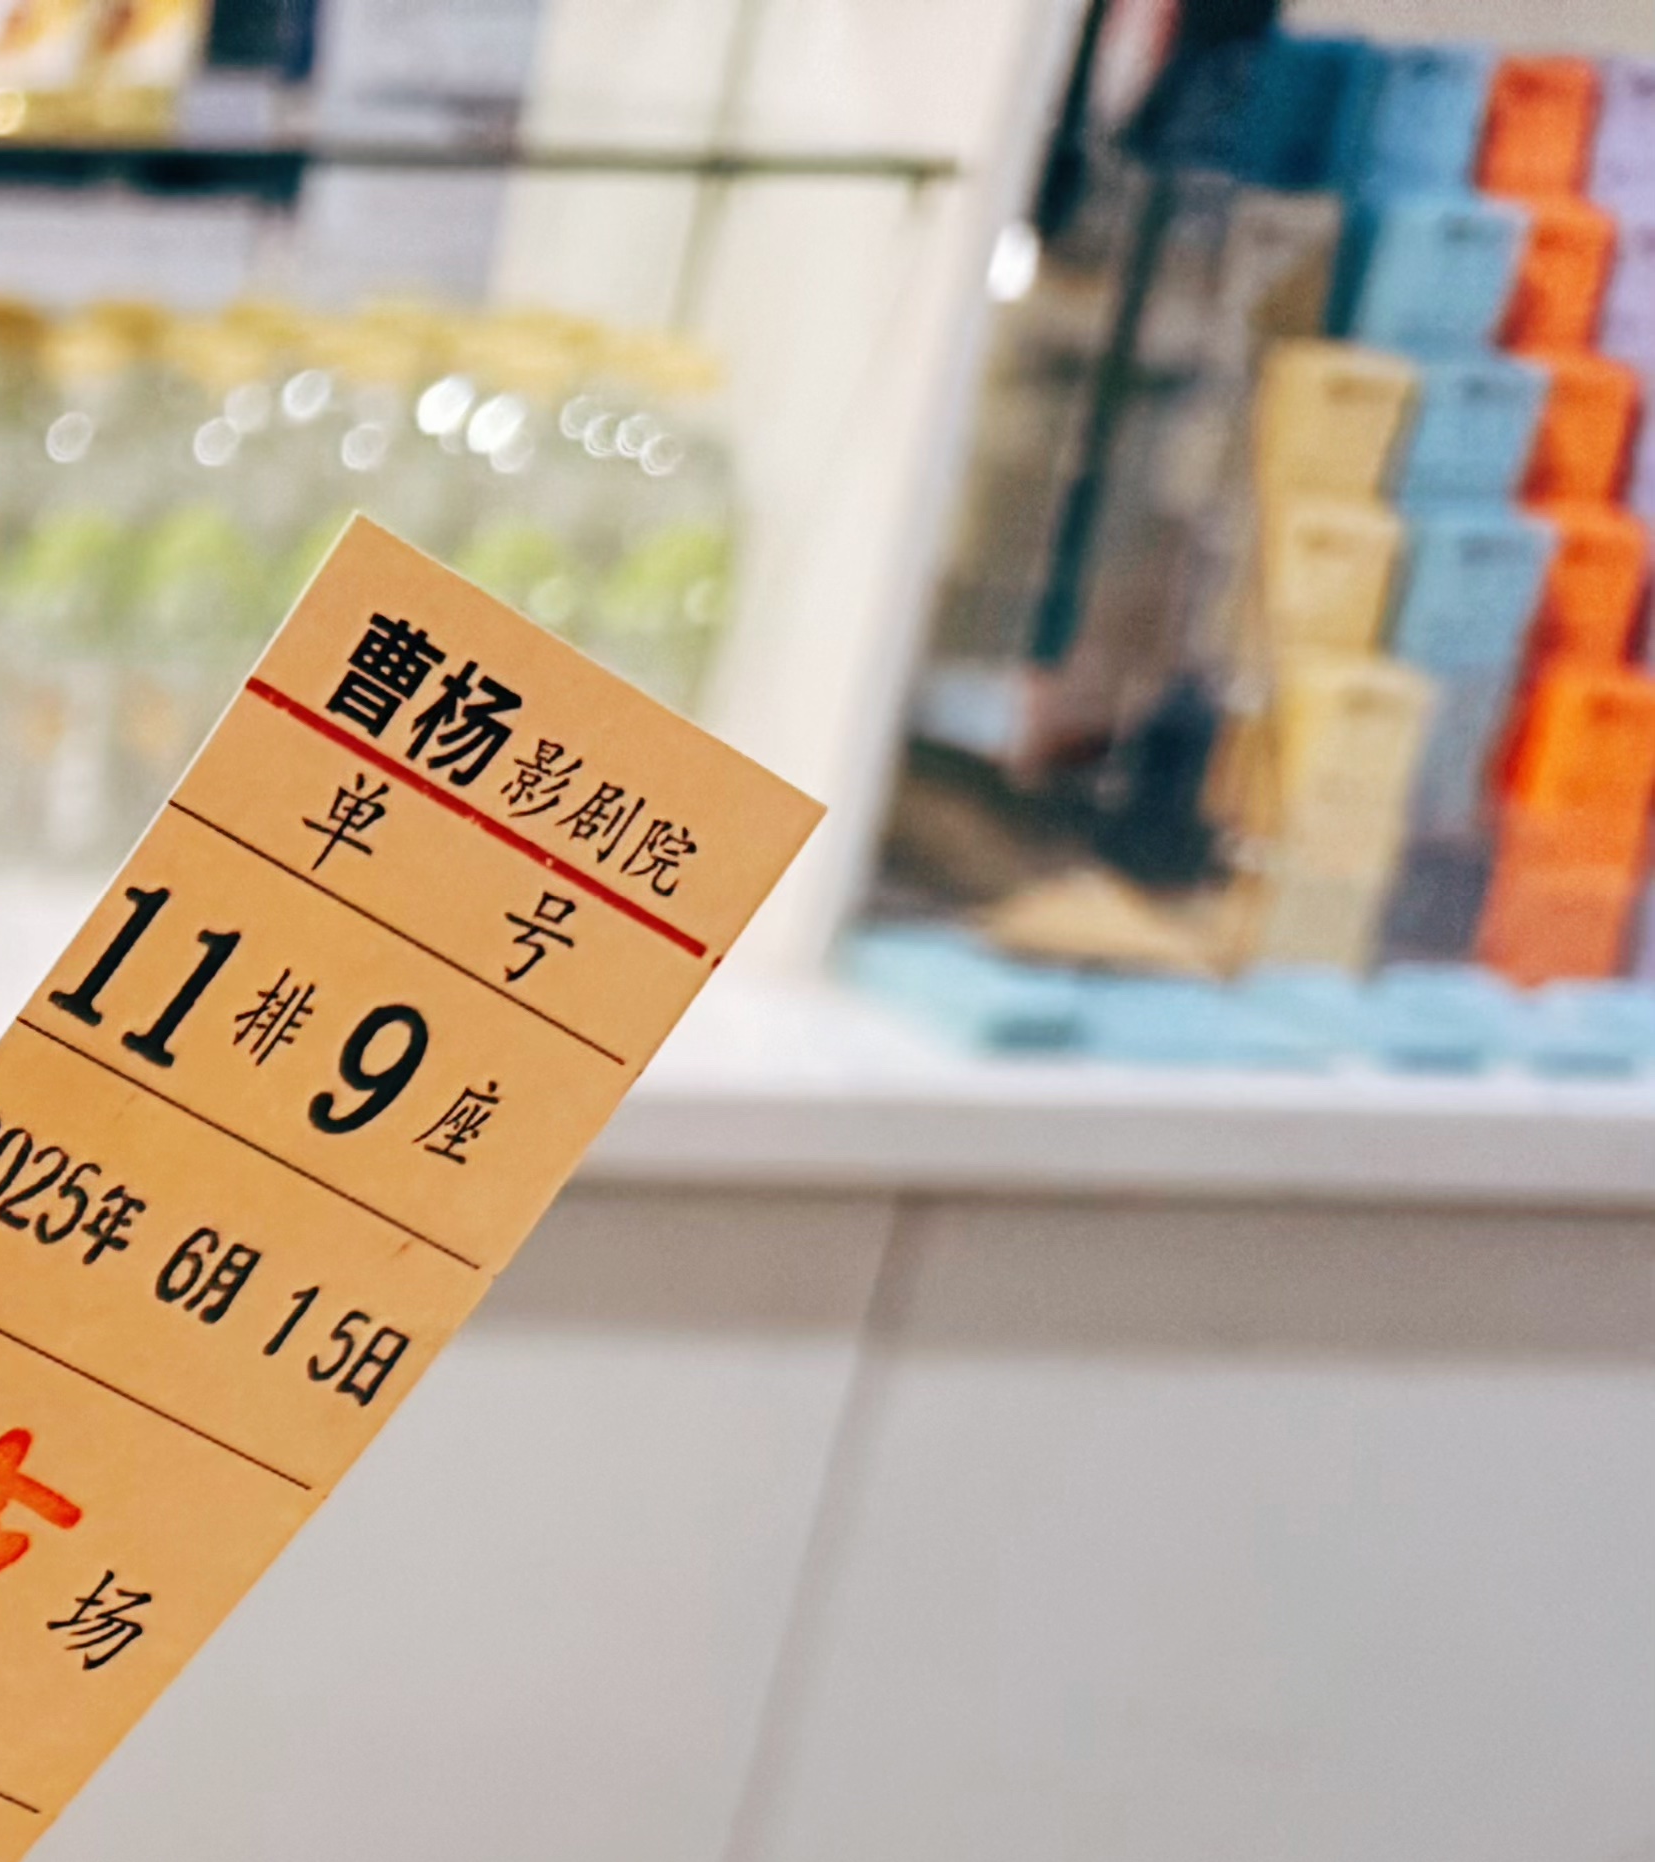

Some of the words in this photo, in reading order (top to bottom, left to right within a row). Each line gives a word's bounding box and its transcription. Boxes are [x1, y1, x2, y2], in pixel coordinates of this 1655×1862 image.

[324, 612, 698, 898] 曹杨影剧院
[155, 1227, 262, 1324] 6月
